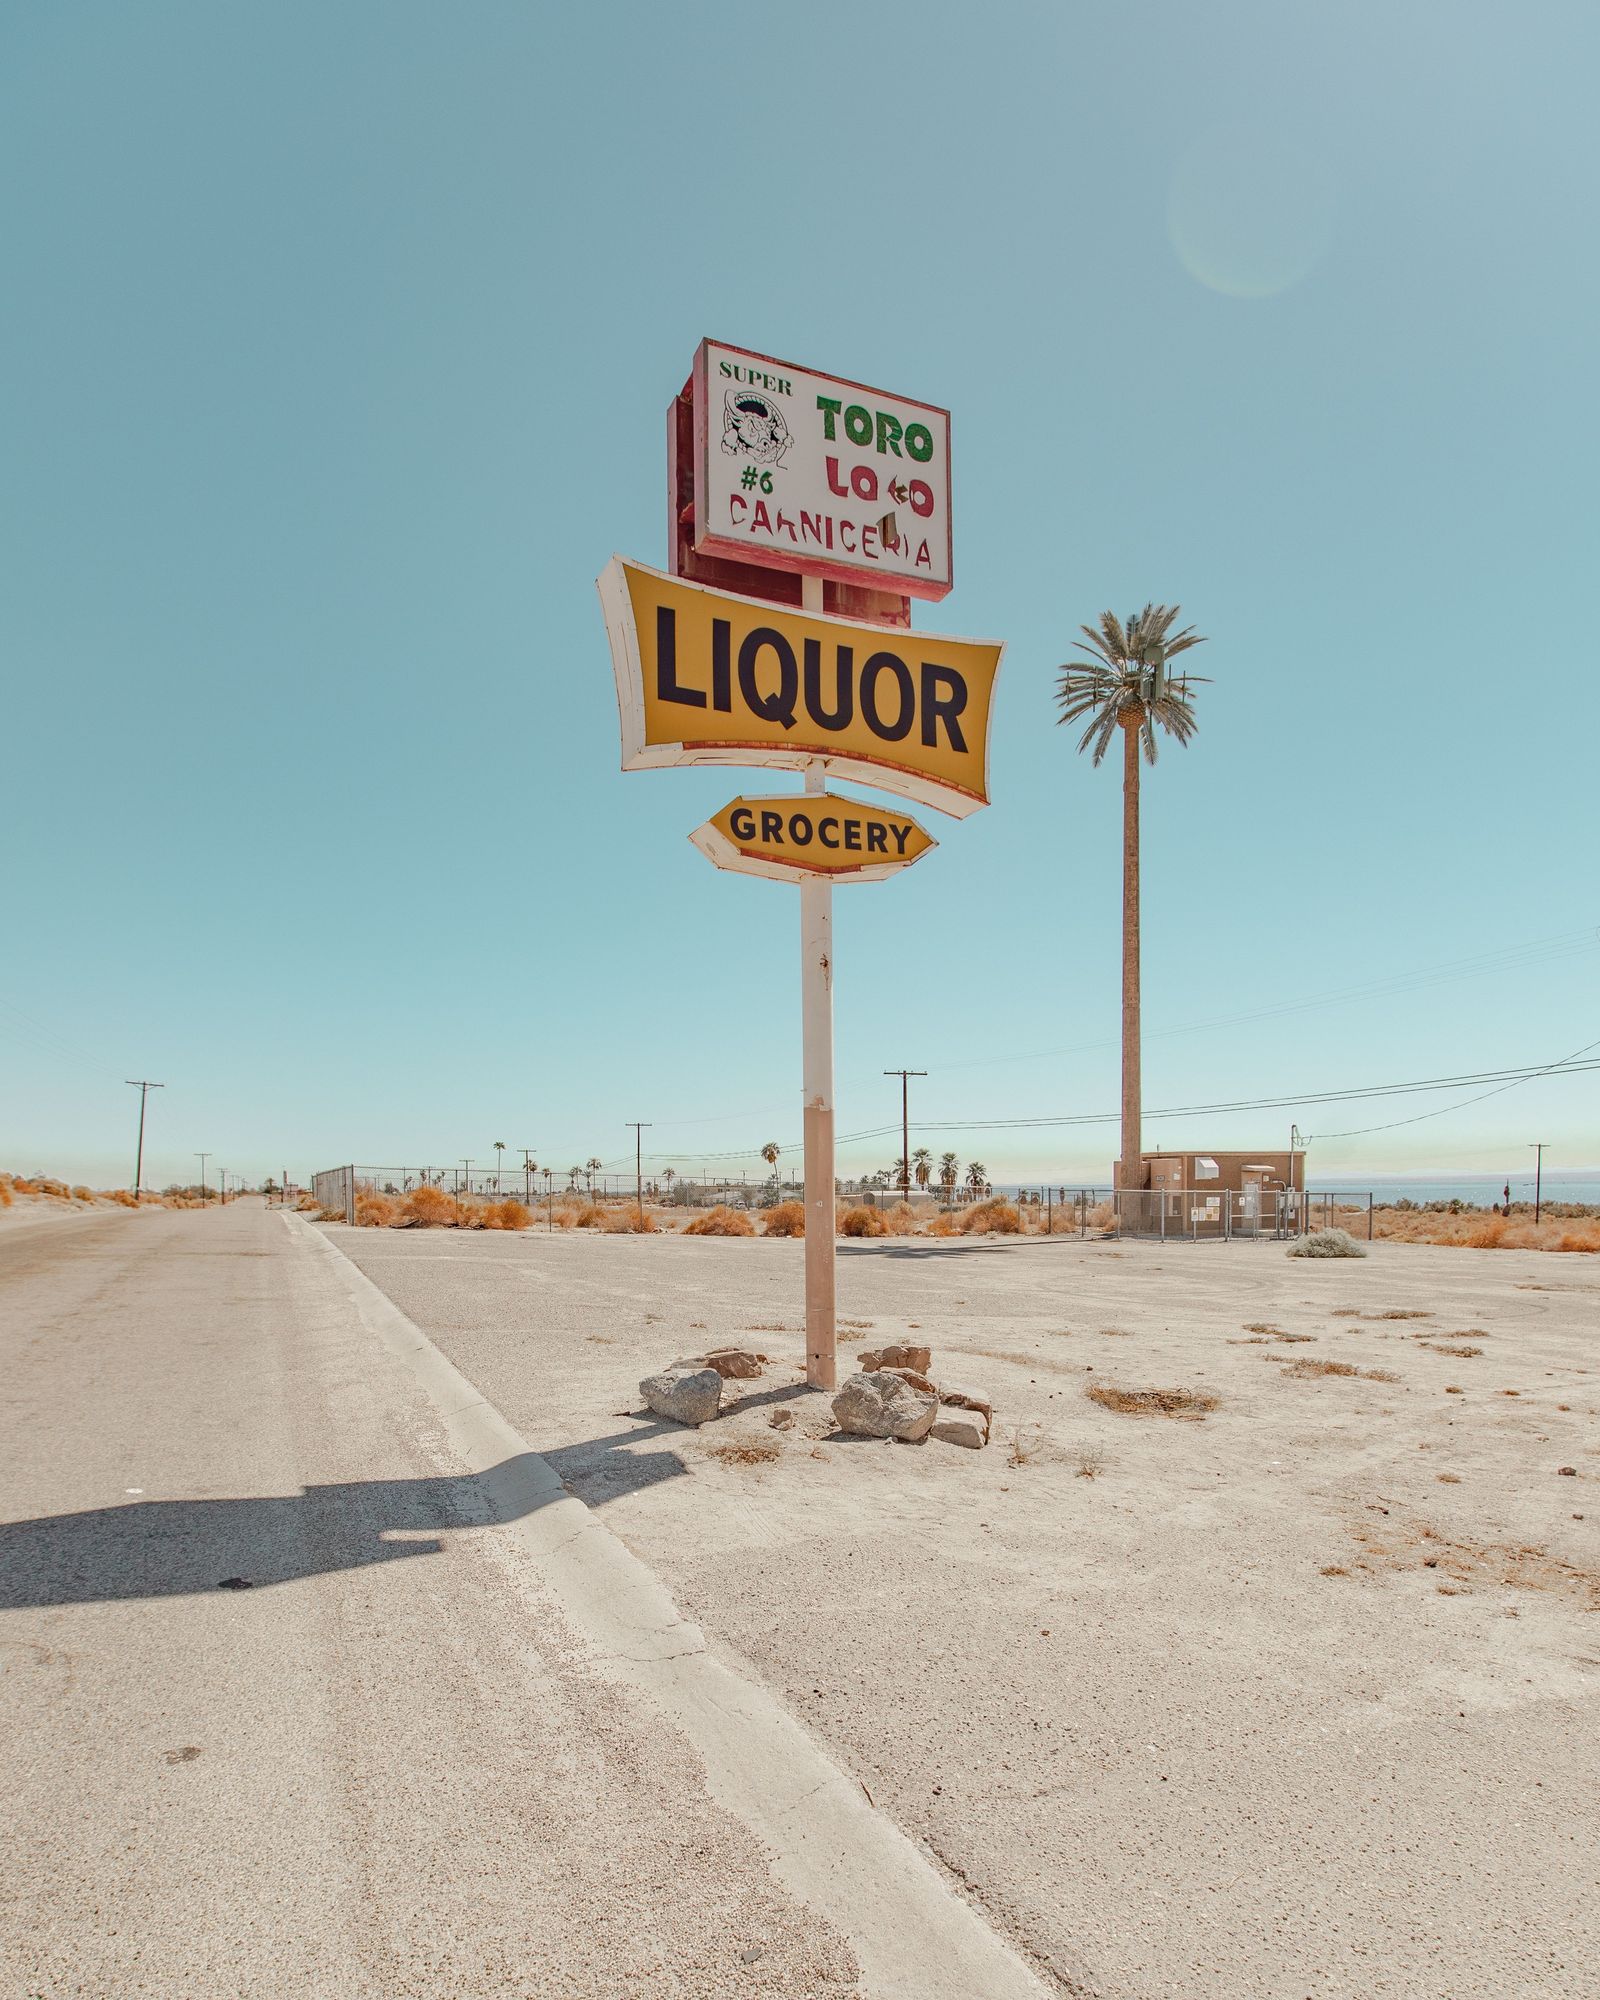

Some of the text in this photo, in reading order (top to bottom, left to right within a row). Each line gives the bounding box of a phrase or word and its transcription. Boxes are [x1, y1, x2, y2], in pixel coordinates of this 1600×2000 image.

[719, 361, 794, 397] SUPER
[816, 395, 934, 463] TORO
[740, 465, 774, 495] #6
[656, 605, 970, 754] LIQUOR
[729, 808, 913, 855] GROCERY
